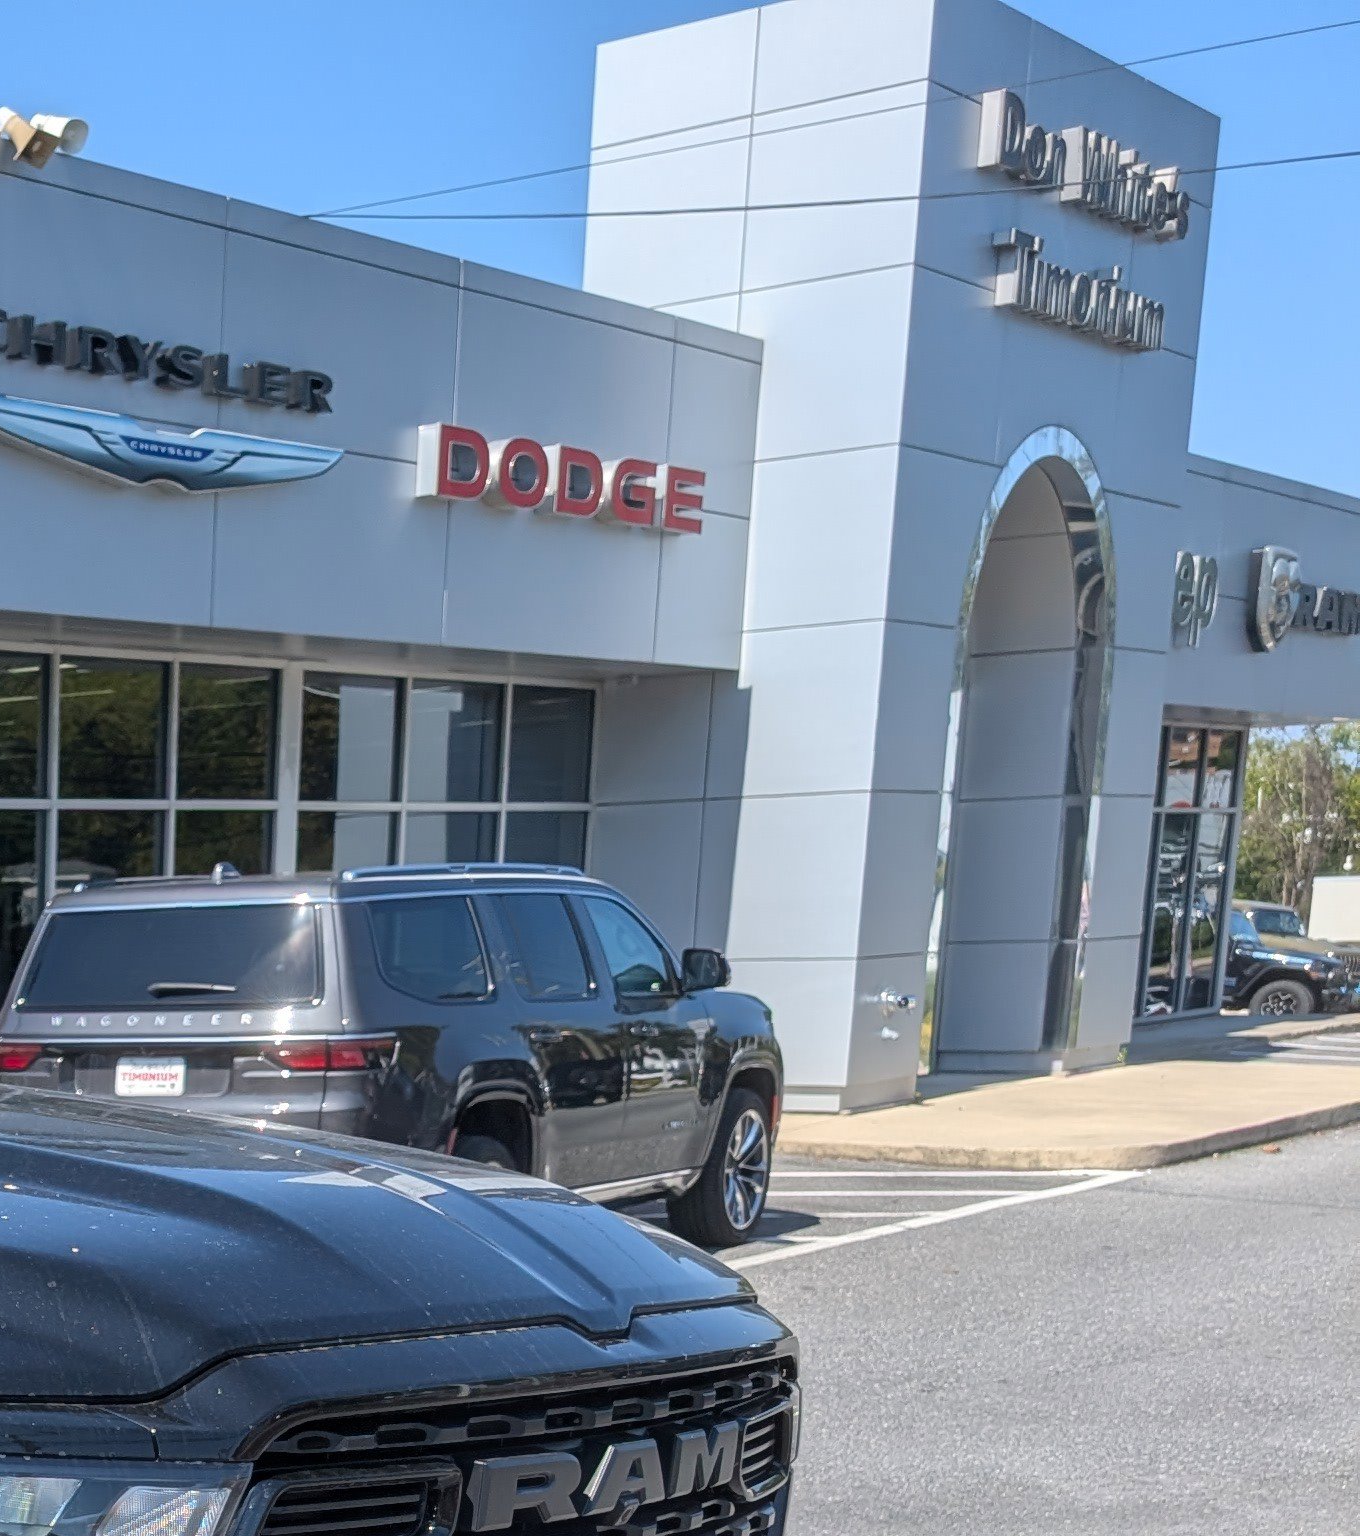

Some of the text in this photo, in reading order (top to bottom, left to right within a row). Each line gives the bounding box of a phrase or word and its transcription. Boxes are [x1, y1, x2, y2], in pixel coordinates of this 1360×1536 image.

[977, 88, 1066, 185] Don
[129, 440, 202, 459] CHRYSLER
[416, 421, 707, 535] DODGE
[51, 1013, 254, 1028] WAGONEER
[121, 1072, 179, 1082] TIMONIUM
[466, 1420, 740, 1531] RAM
